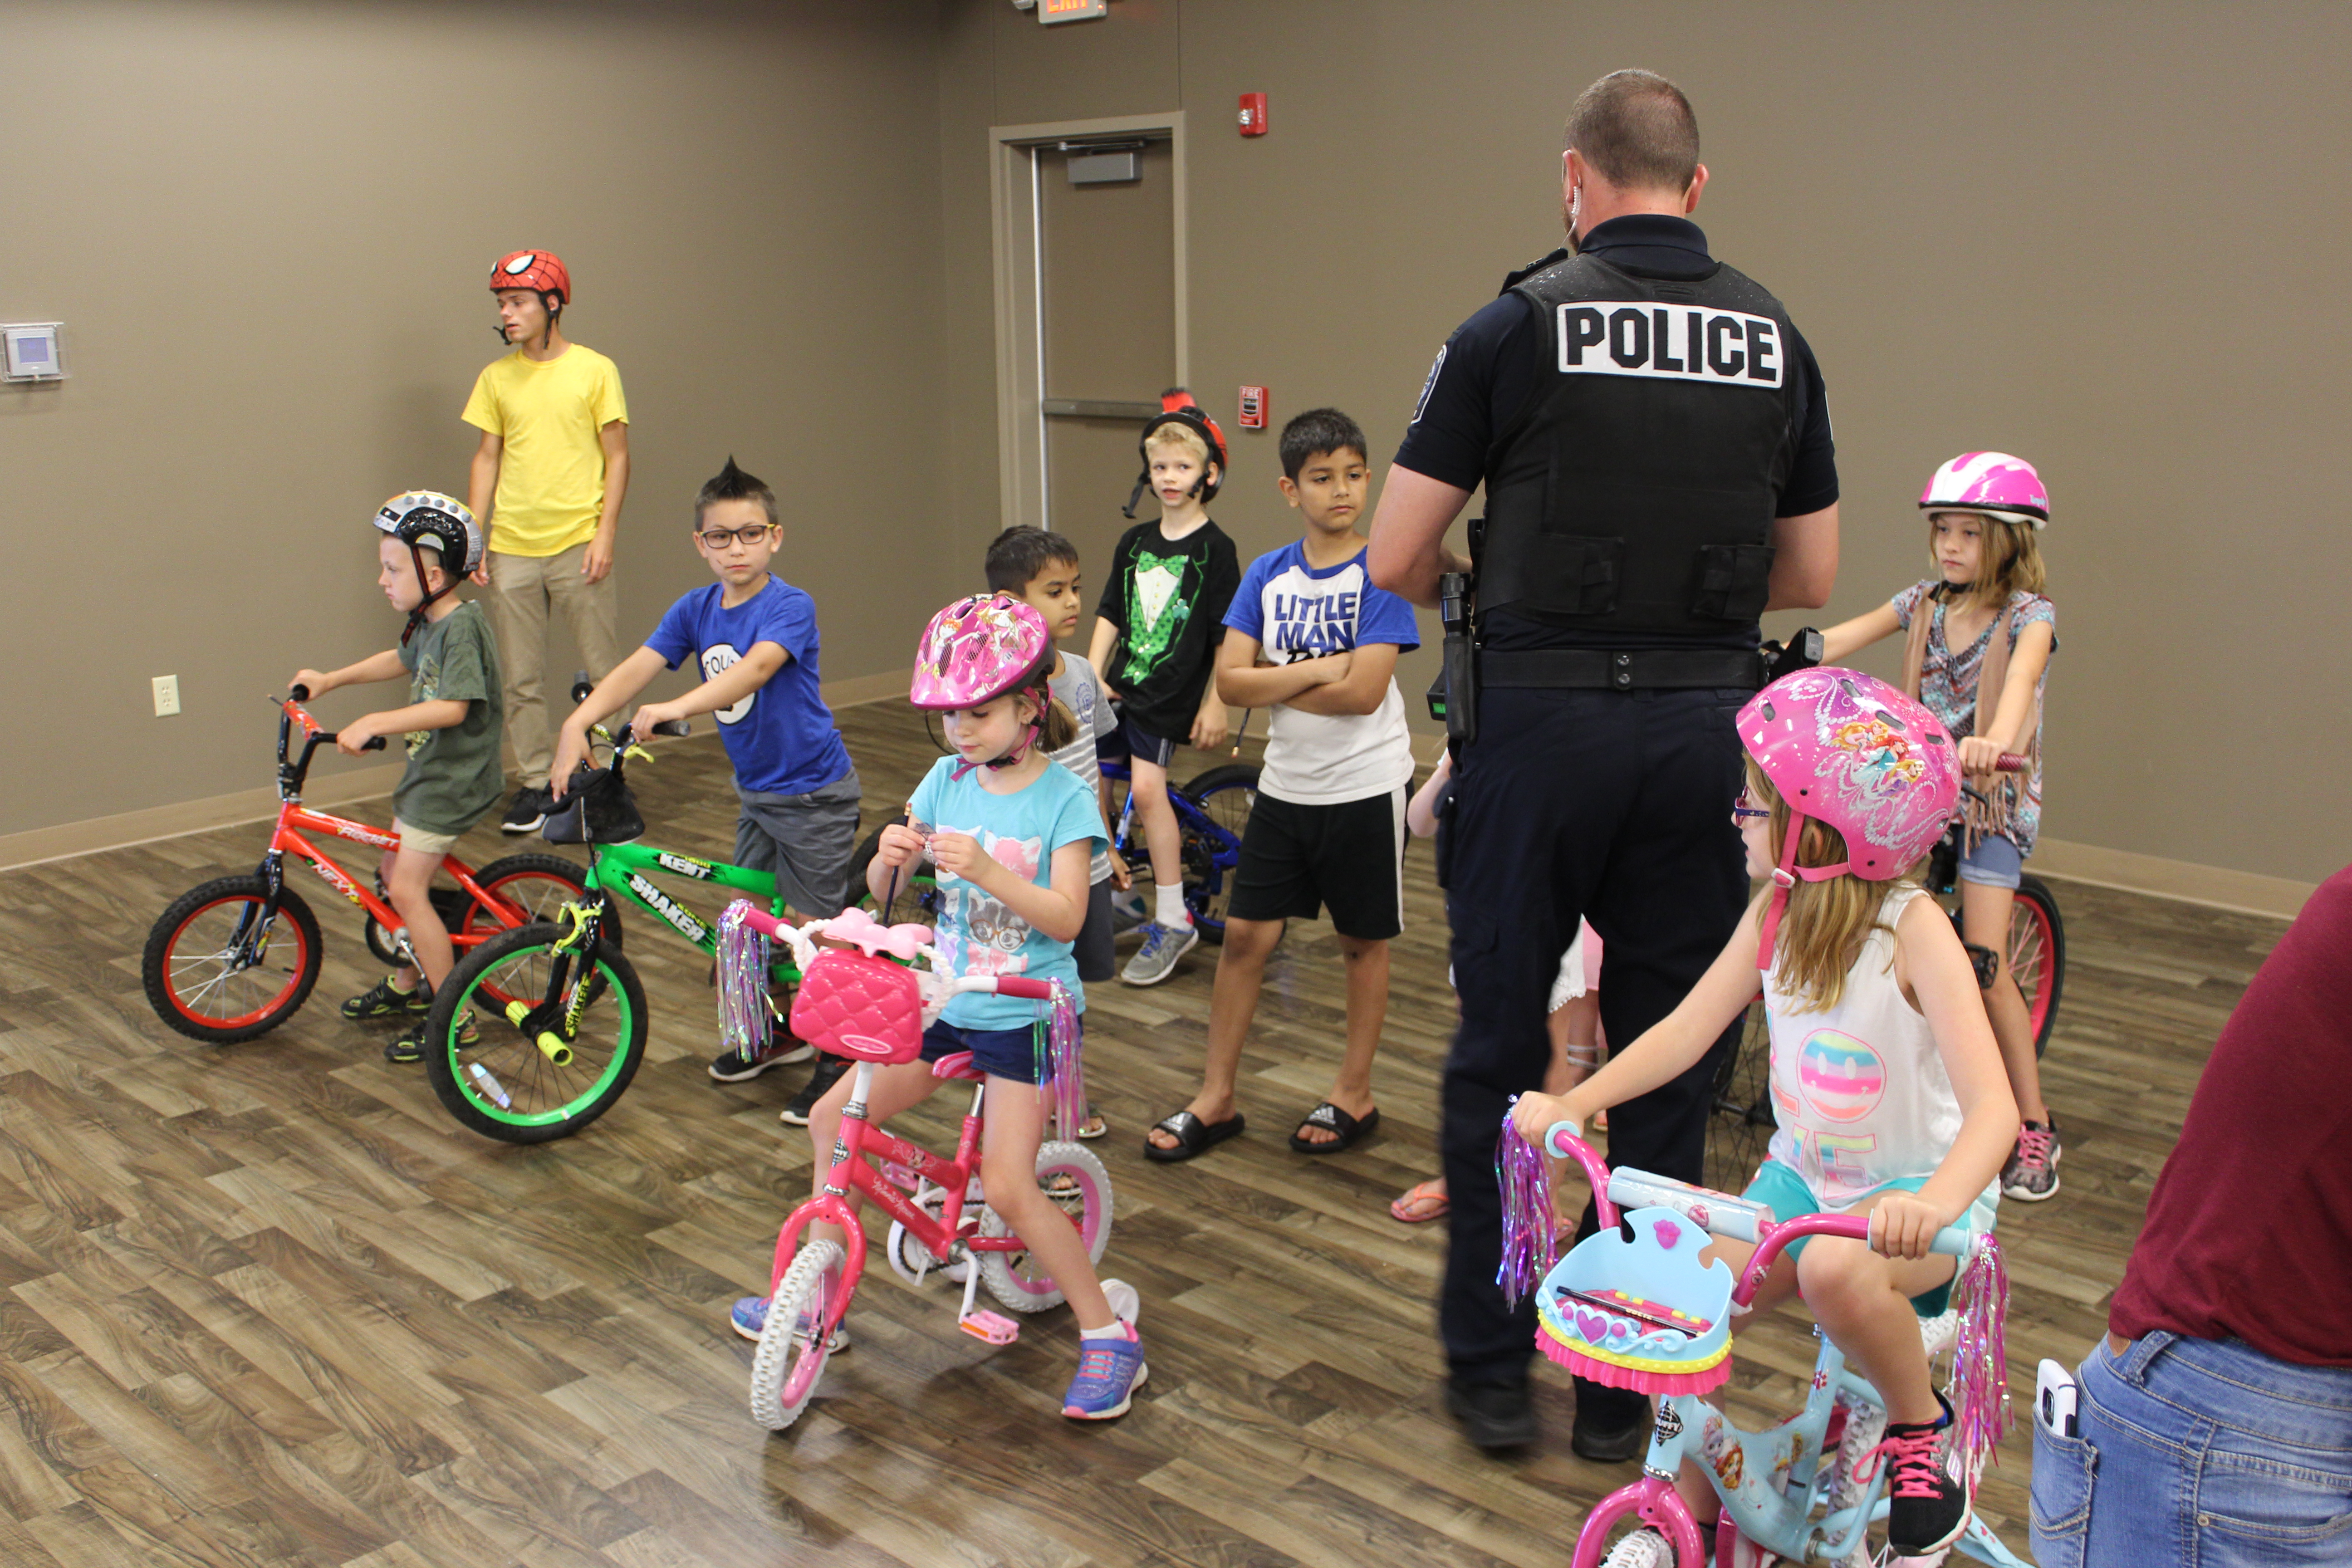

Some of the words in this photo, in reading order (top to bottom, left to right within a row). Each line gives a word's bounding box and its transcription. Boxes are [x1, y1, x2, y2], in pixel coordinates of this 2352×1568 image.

[1565, 307, 1777, 382] POLICE
[1274, 592, 1357, 623] LITTLE
[1276, 621, 1356, 652] MAN
[311, 863, 360, 897] NEXT
[659, 853, 711, 879] KENT
[629, 874, 706, 942] SHAKER
